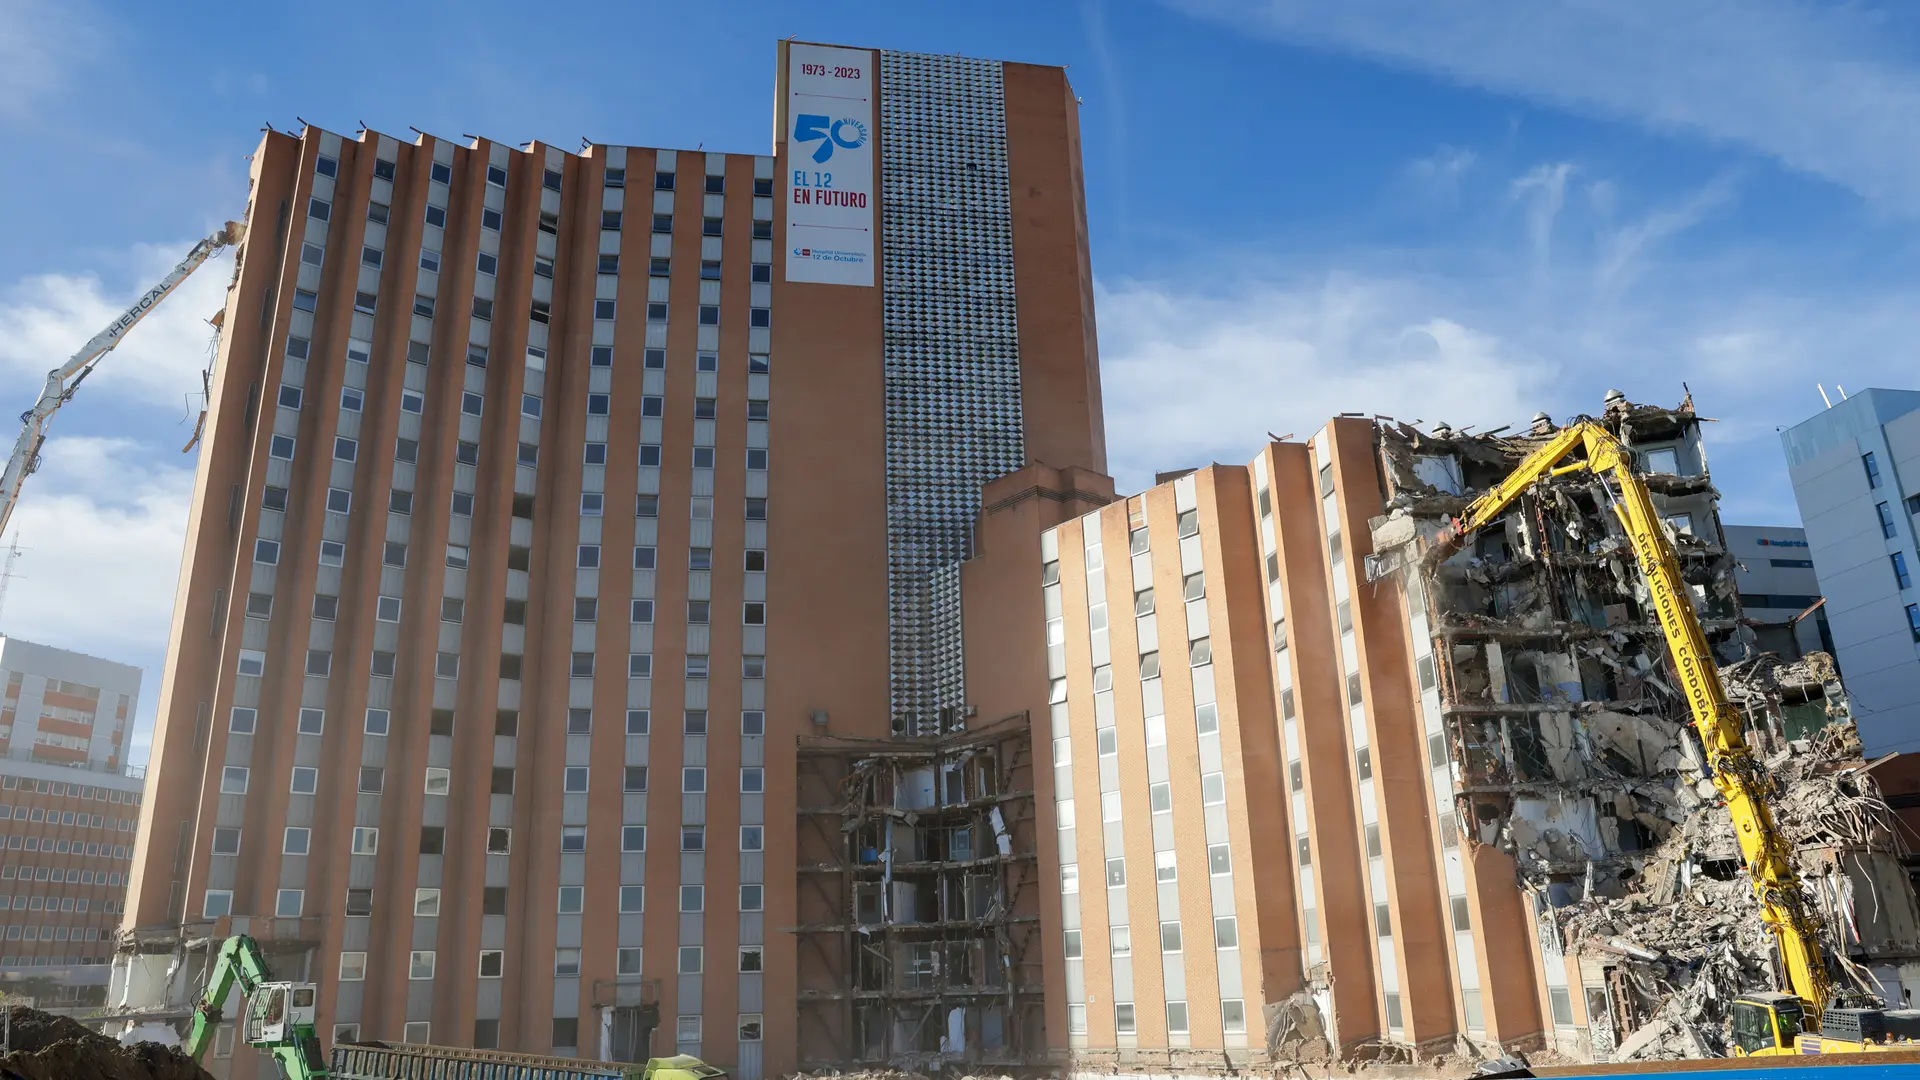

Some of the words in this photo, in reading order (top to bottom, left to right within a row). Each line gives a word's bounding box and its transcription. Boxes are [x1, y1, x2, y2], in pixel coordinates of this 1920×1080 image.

[801, 63, 826, 77] 1973
[834, 66, 861, 80] 2023
[794, 170, 810, 187] EL
[814, 171, 832, 188] 12
[794, 188, 811, 205] EN
[816, 190, 867, 209] FUTURO
[833, 254, 864, 264] Octubre
[110, 284, 172, 336] HERCAL
